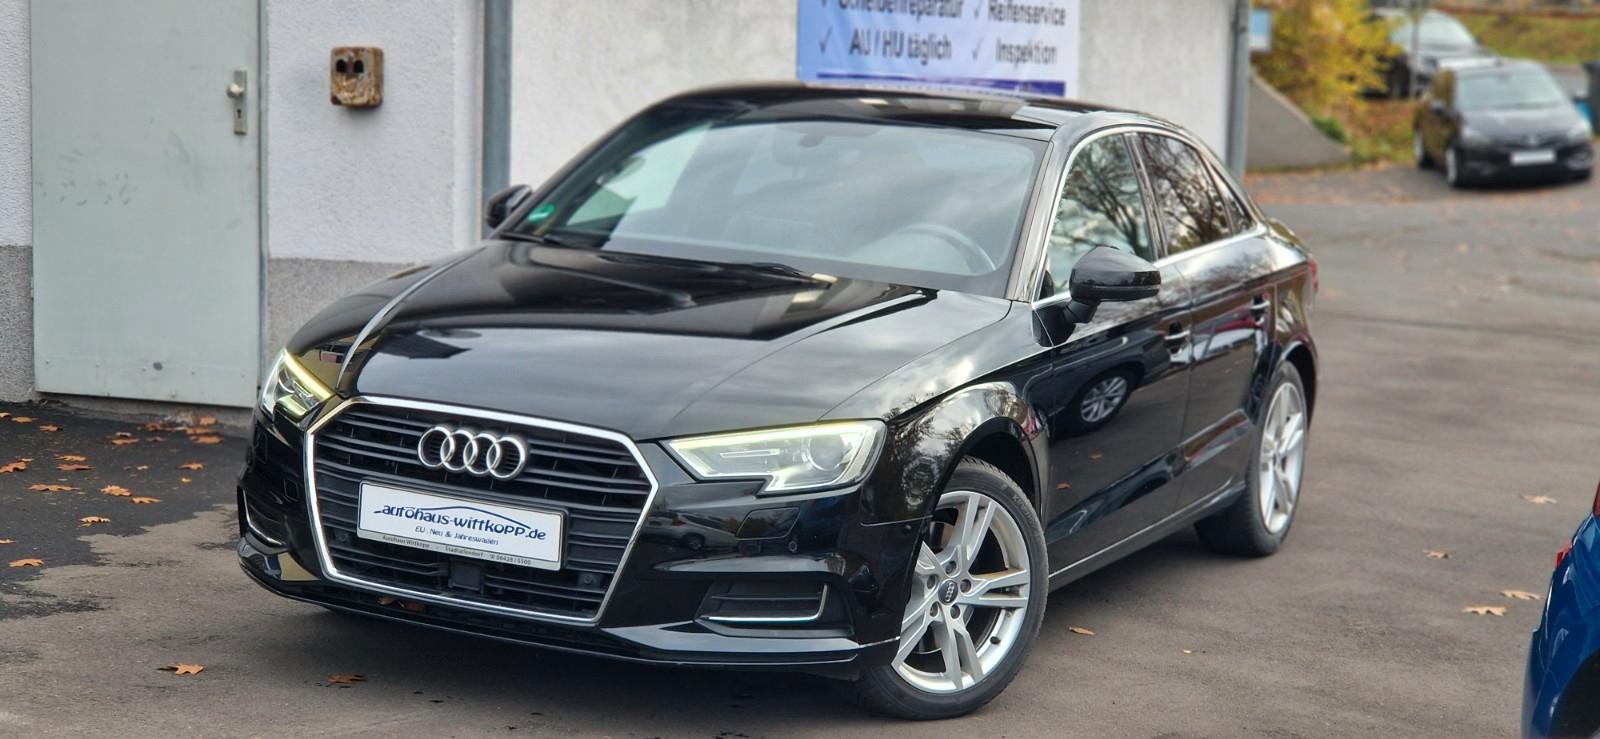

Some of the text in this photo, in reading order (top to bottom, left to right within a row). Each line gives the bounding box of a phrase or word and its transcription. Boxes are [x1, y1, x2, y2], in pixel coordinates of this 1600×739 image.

[988, 0, 1066, 26] Reifenservice
[849, 29, 870, 55] AU
[882, 30, 904, 58] HU
[907, 32, 952, 66] täglich
[996, 37, 1058, 69] Inspektion
[382, 504, 547, 541] autohaus-wittkopp.de
